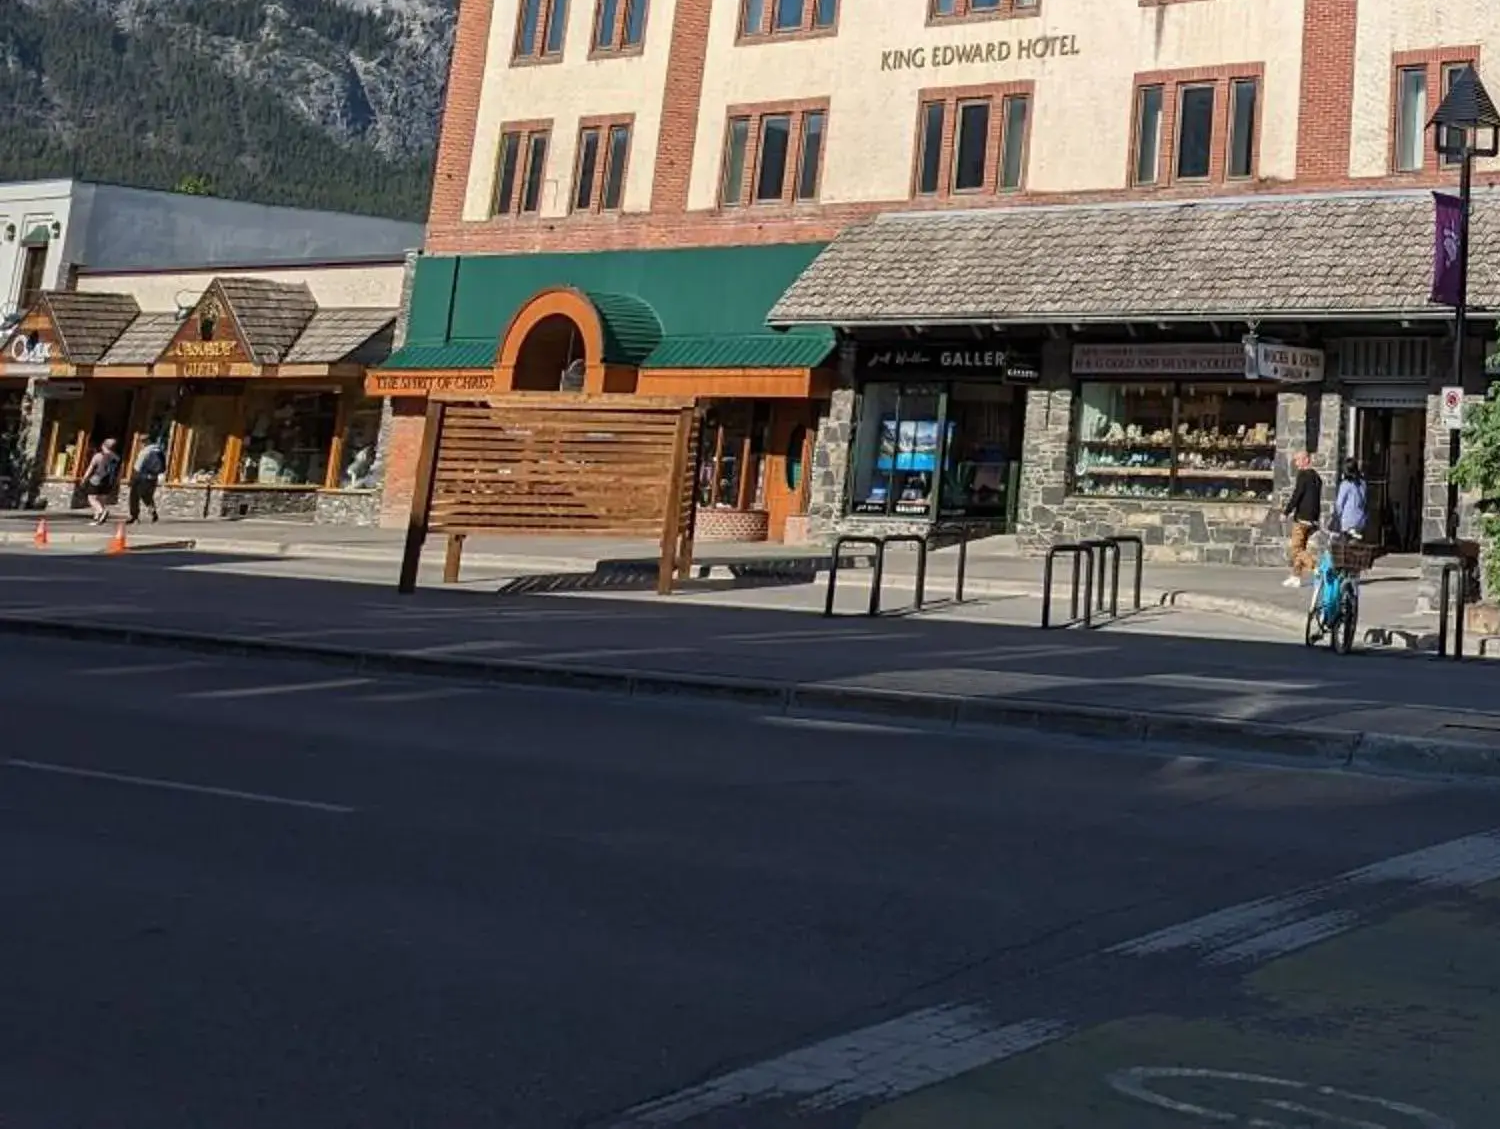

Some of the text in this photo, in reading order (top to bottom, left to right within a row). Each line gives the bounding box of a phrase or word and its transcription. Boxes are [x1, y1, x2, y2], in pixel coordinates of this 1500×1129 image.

[880, 34, 1081, 72] KING EDWARD HOTEL
[940, 351, 1007, 366] GALLER
[1199, 357, 1246, 370] COLLECT
[437, 374, 452, 389] OF
